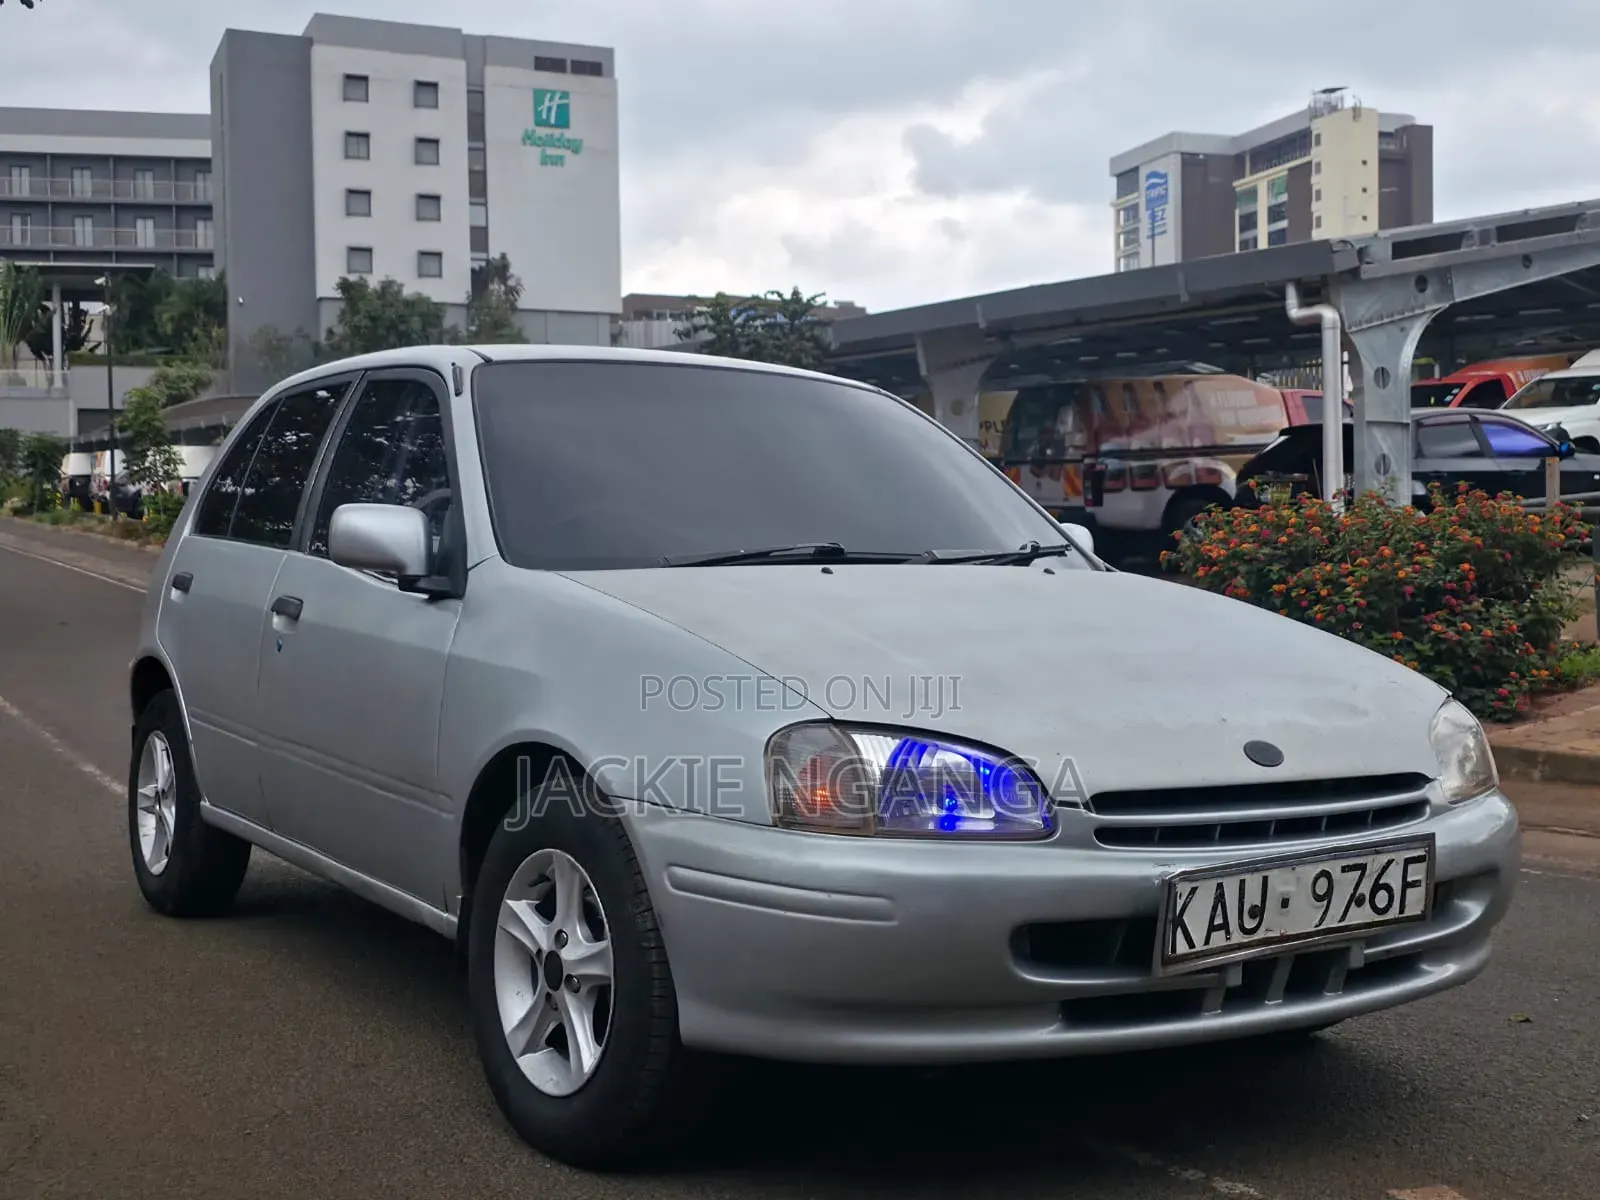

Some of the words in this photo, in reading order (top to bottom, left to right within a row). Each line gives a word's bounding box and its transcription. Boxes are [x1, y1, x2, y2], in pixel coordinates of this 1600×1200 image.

[521, 128, 583, 155] Holiday
[539, 148, 565, 167] Inn
[1169, 875, 1269, 955] KAU
[1310, 854, 1427, 928] 976F
